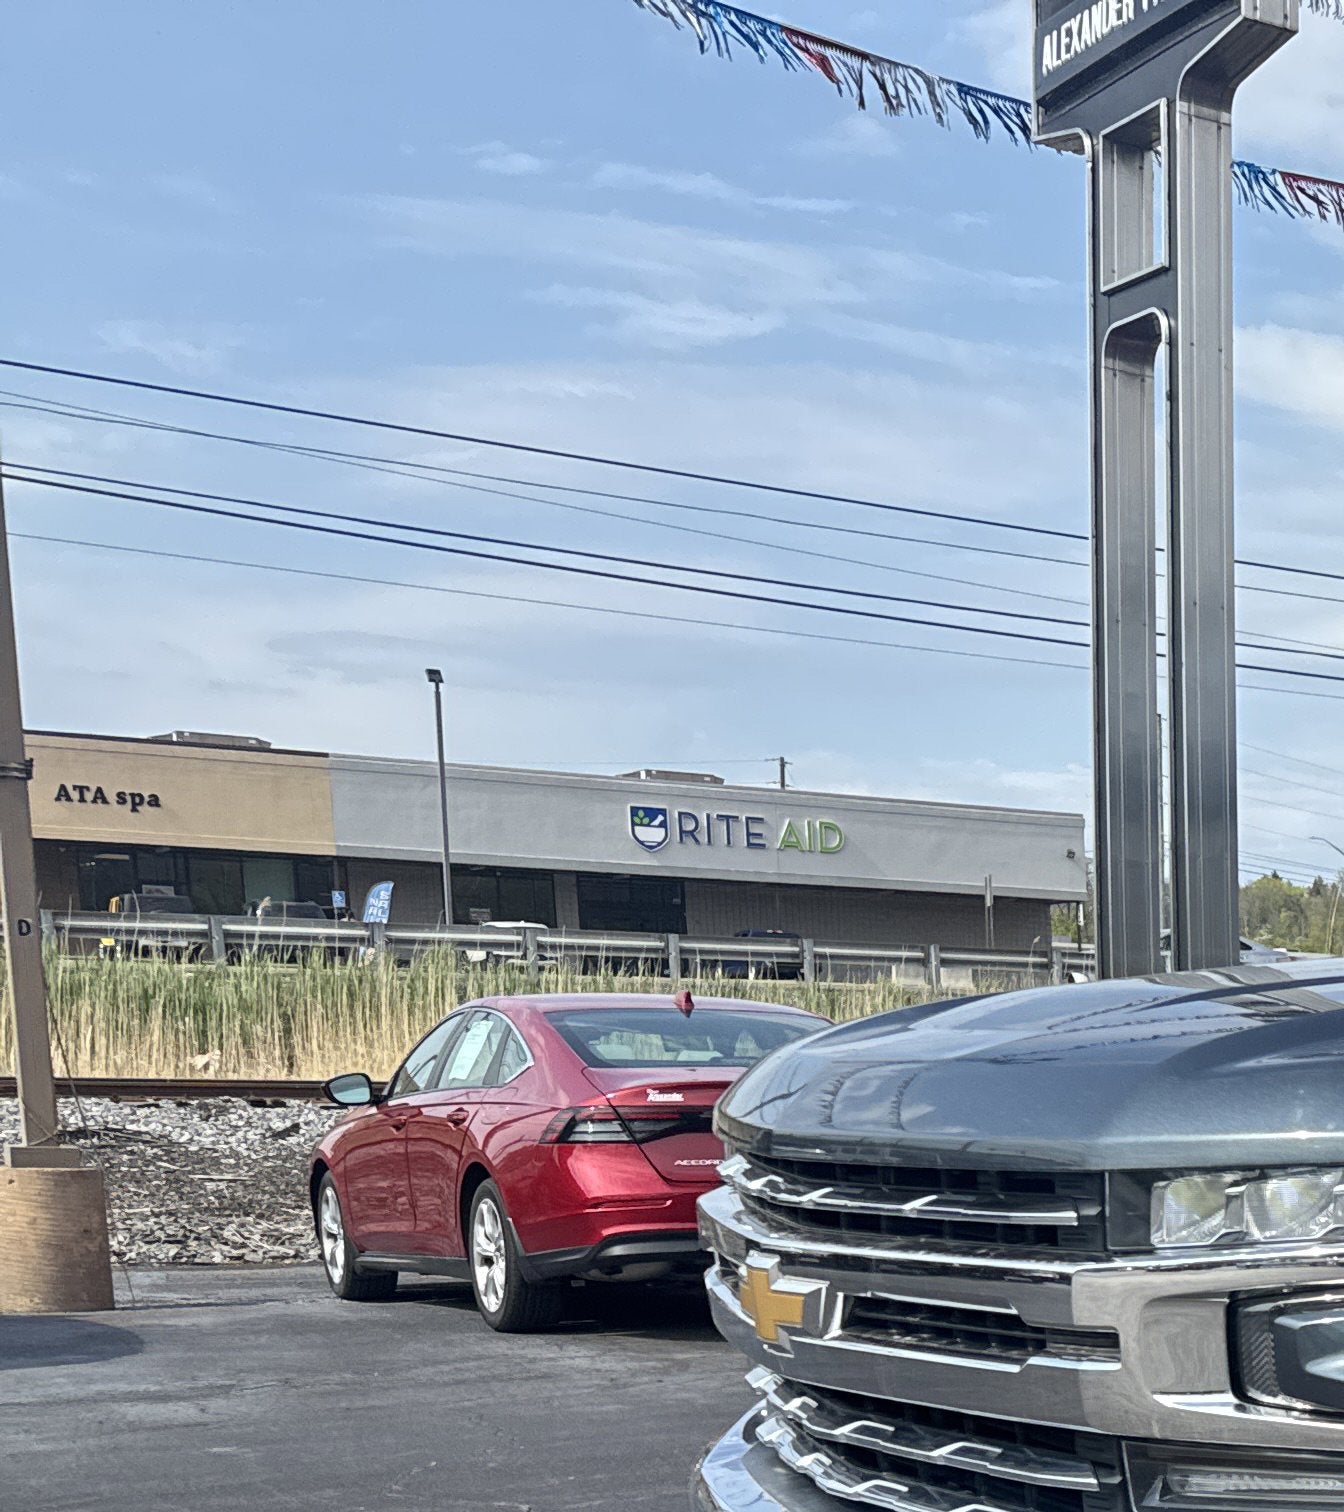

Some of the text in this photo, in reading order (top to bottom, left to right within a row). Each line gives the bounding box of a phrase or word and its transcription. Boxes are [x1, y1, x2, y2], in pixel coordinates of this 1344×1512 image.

[1042, 0, 1135, 77] ALEXANDER
[54, 783, 161, 813] ATA spa
[676, 809, 845, 854] RITE AID
[18, 919, 31, 936] D
